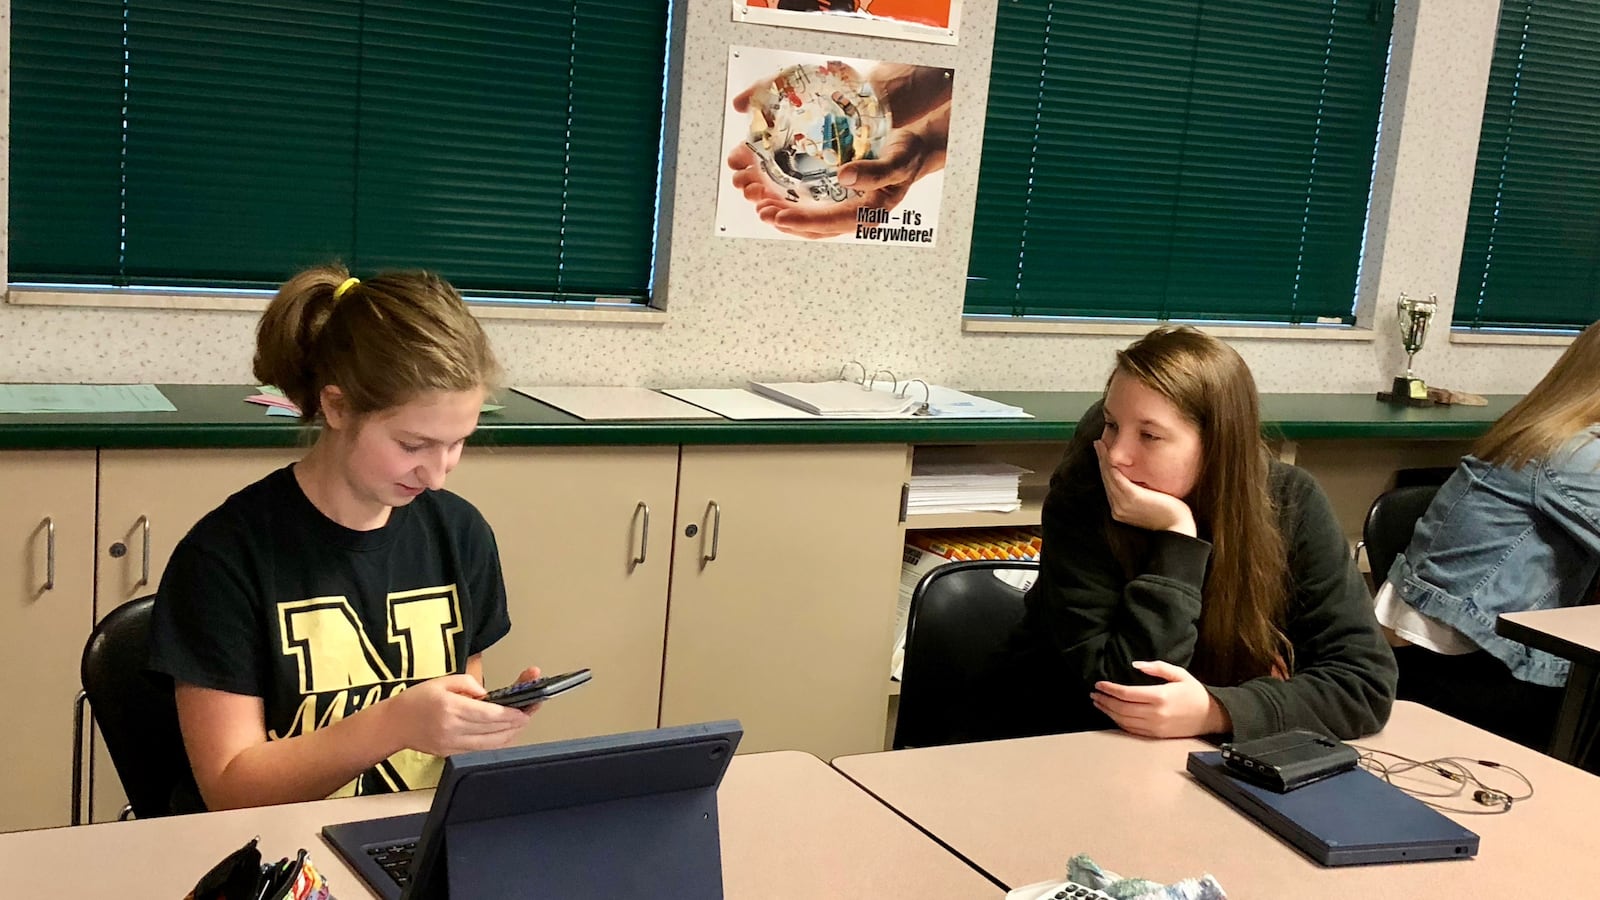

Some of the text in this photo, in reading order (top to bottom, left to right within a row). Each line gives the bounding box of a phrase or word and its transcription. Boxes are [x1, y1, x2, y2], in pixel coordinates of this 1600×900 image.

[858, 207, 889, 224] Math
[902, 209, 922, 225] it's
[856, 224, 933, 242] Everywhere!
